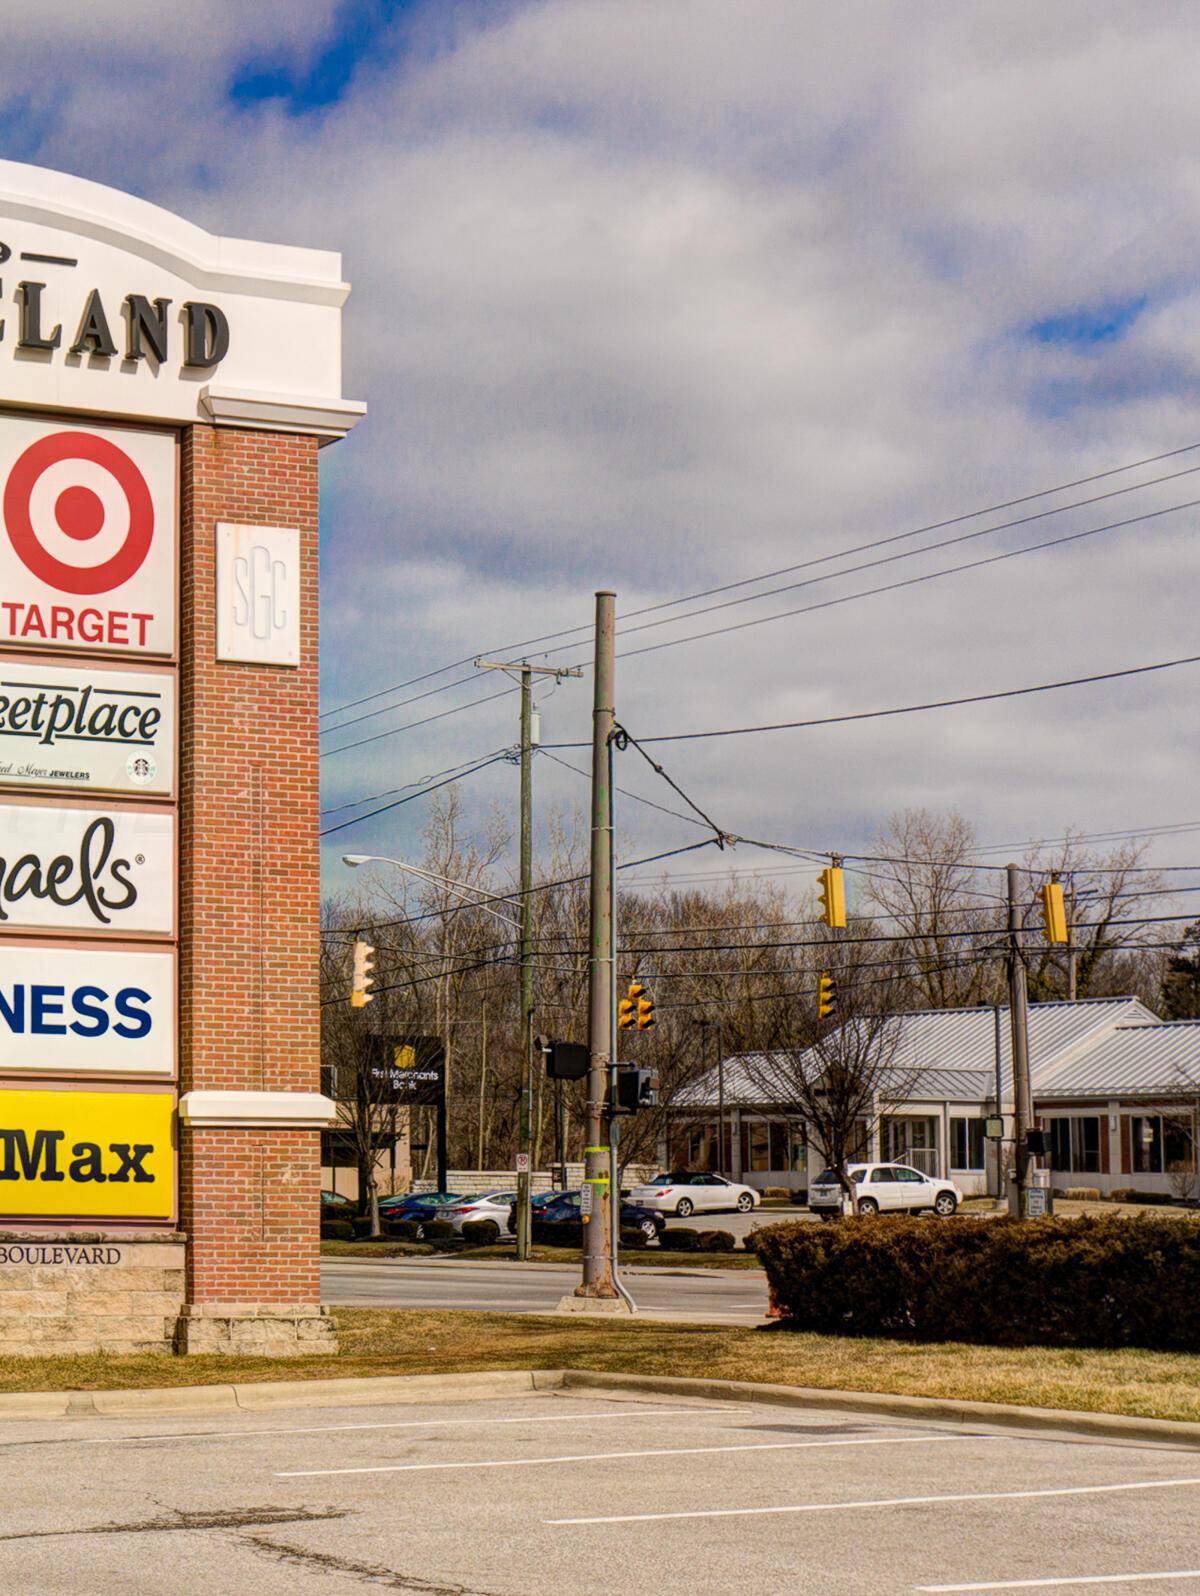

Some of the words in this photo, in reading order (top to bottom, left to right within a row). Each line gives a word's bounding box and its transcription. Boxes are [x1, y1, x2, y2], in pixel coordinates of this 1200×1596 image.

[1, 602, 154, 647] TARGET
[49, 770, 90, 780] JEWELERS
[393, 1080, 417, 1090] Bak
